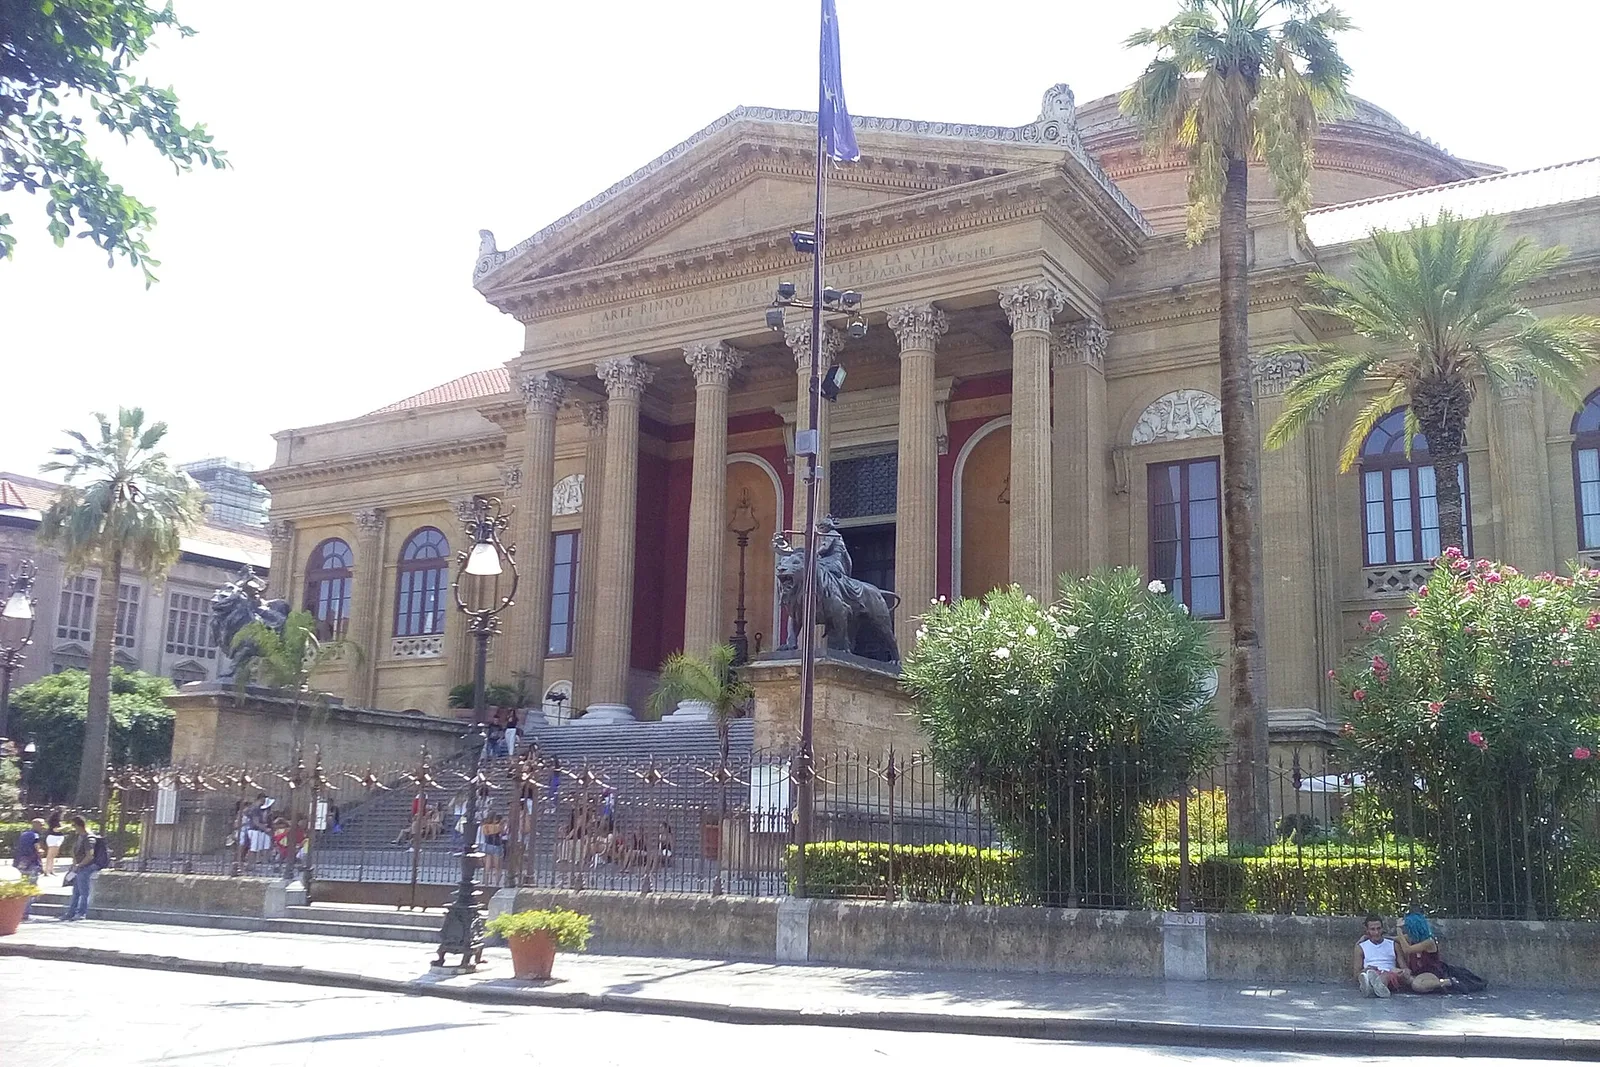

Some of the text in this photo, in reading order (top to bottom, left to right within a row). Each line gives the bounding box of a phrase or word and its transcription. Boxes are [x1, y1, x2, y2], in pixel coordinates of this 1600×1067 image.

[640, 292, 701, 315] RINNOVA
[885, 252, 901, 266] LA
[911, 242, 949, 261] VITA
[849, 262, 913, 283] PREPARAR
